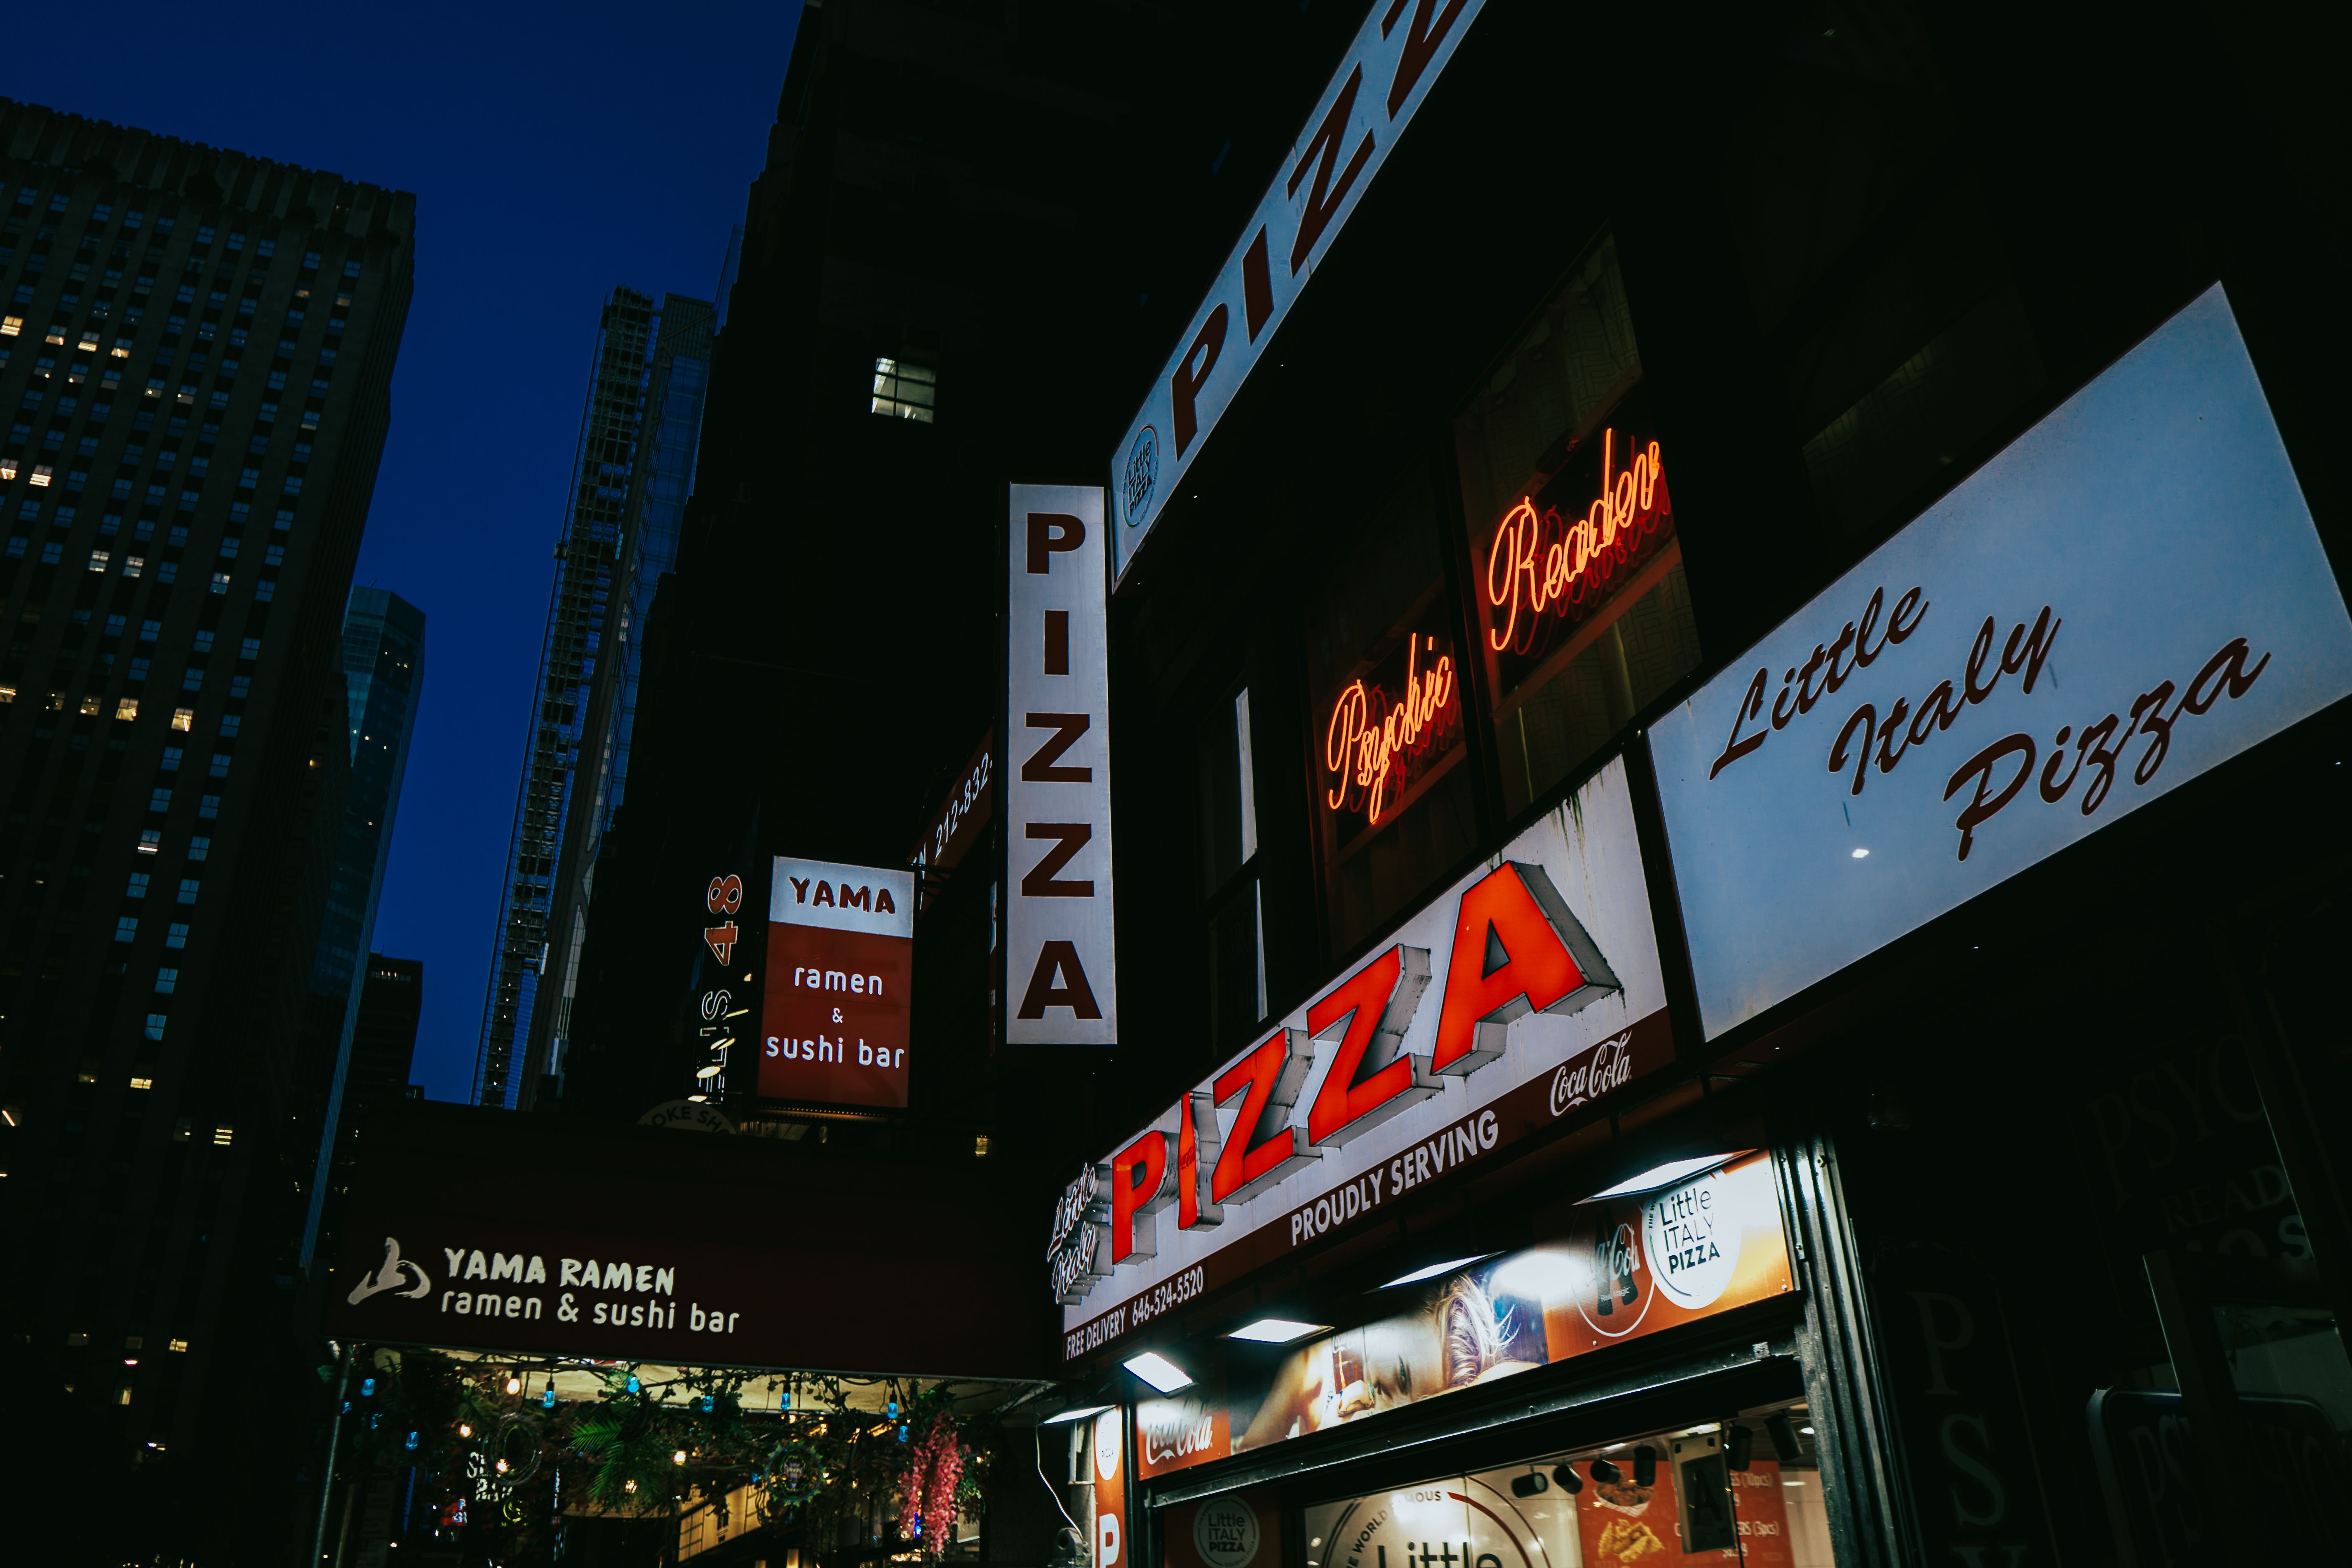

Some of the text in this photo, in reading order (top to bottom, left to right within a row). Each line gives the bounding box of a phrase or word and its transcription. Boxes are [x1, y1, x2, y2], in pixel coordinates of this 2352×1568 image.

[1128, 441, 1151, 487] Little
[1128, 453, 1151, 503] ITALY
[1129, 474, 1152, 517] PIZZA
[1709, 586, 1929, 781] Little
[1828, 606, 2061, 796] Italy
[1328, 632, 1452, 824] Psychic
[1943, 637, 2271, 861] Pizza
[1017, 512, 1103, 1020] PIZZA
[789, 877, 895, 914] YAMA
[705, 874, 742, 966] 48
[794, 967, 882, 995] ramen
[832, 1007, 843, 1023] &
[766, 1035, 905, 1068] sushi bar
[1112, 860, 1589, 1265] PIZZA
[646, 1106, 731, 1134] OKE SH
[1291, 1110, 1499, 1246] PROUDLY SERVING
[1048, 1161, 1096, 1264] Little
[1659, 1188, 1712, 1226] Little
[1664, 1213, 1714, 1252] ITALY
[444, 1248, 675, 1295] YAMA RAMEN
[1052, 1220, 1097, 1305] Italy
[1668, 1241, 1720, 1274] PIZZA
[441, 1291, 740, 1334] ramen & sushi bar
[1067, 1266, 1203, 1361] FREE DELIVERY 646-524-5520
[1905, 1291, 2029, 1568] PS
[1208, 1513, 1245, 1527] Little
[1208, 1528, 1245, 1541] ITALY
[1353, 1509, 1388, 1554] WORLD
[1209, 1541, 1245, 1553] PIZZA
